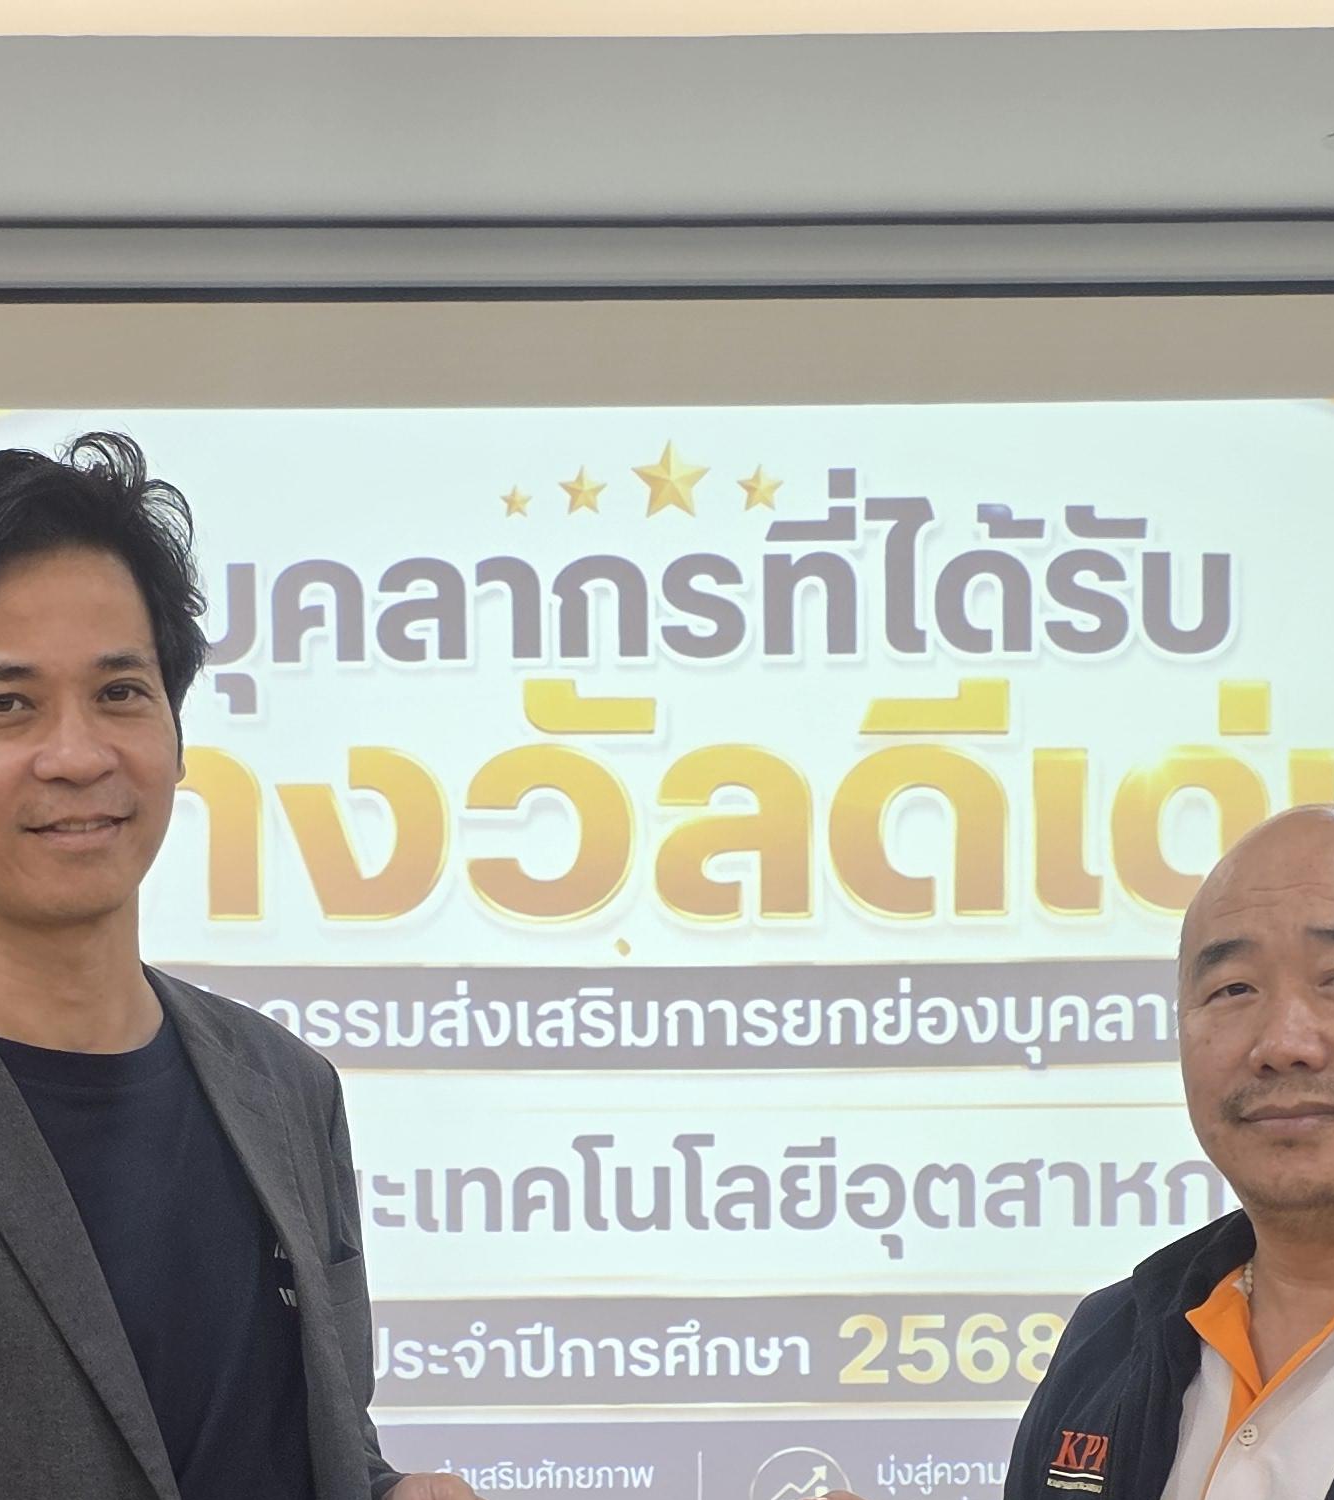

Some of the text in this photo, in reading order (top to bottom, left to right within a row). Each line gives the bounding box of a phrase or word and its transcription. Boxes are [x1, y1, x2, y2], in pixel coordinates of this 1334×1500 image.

[232, 971, 1178, 1066] กรรมส่งเสริมการยกย่องบุคลา
[357, 1133, 1224, 1260] ะเทคโนโลยีอุตสาหก
[838, 1312, 1065, 1385] 2568
